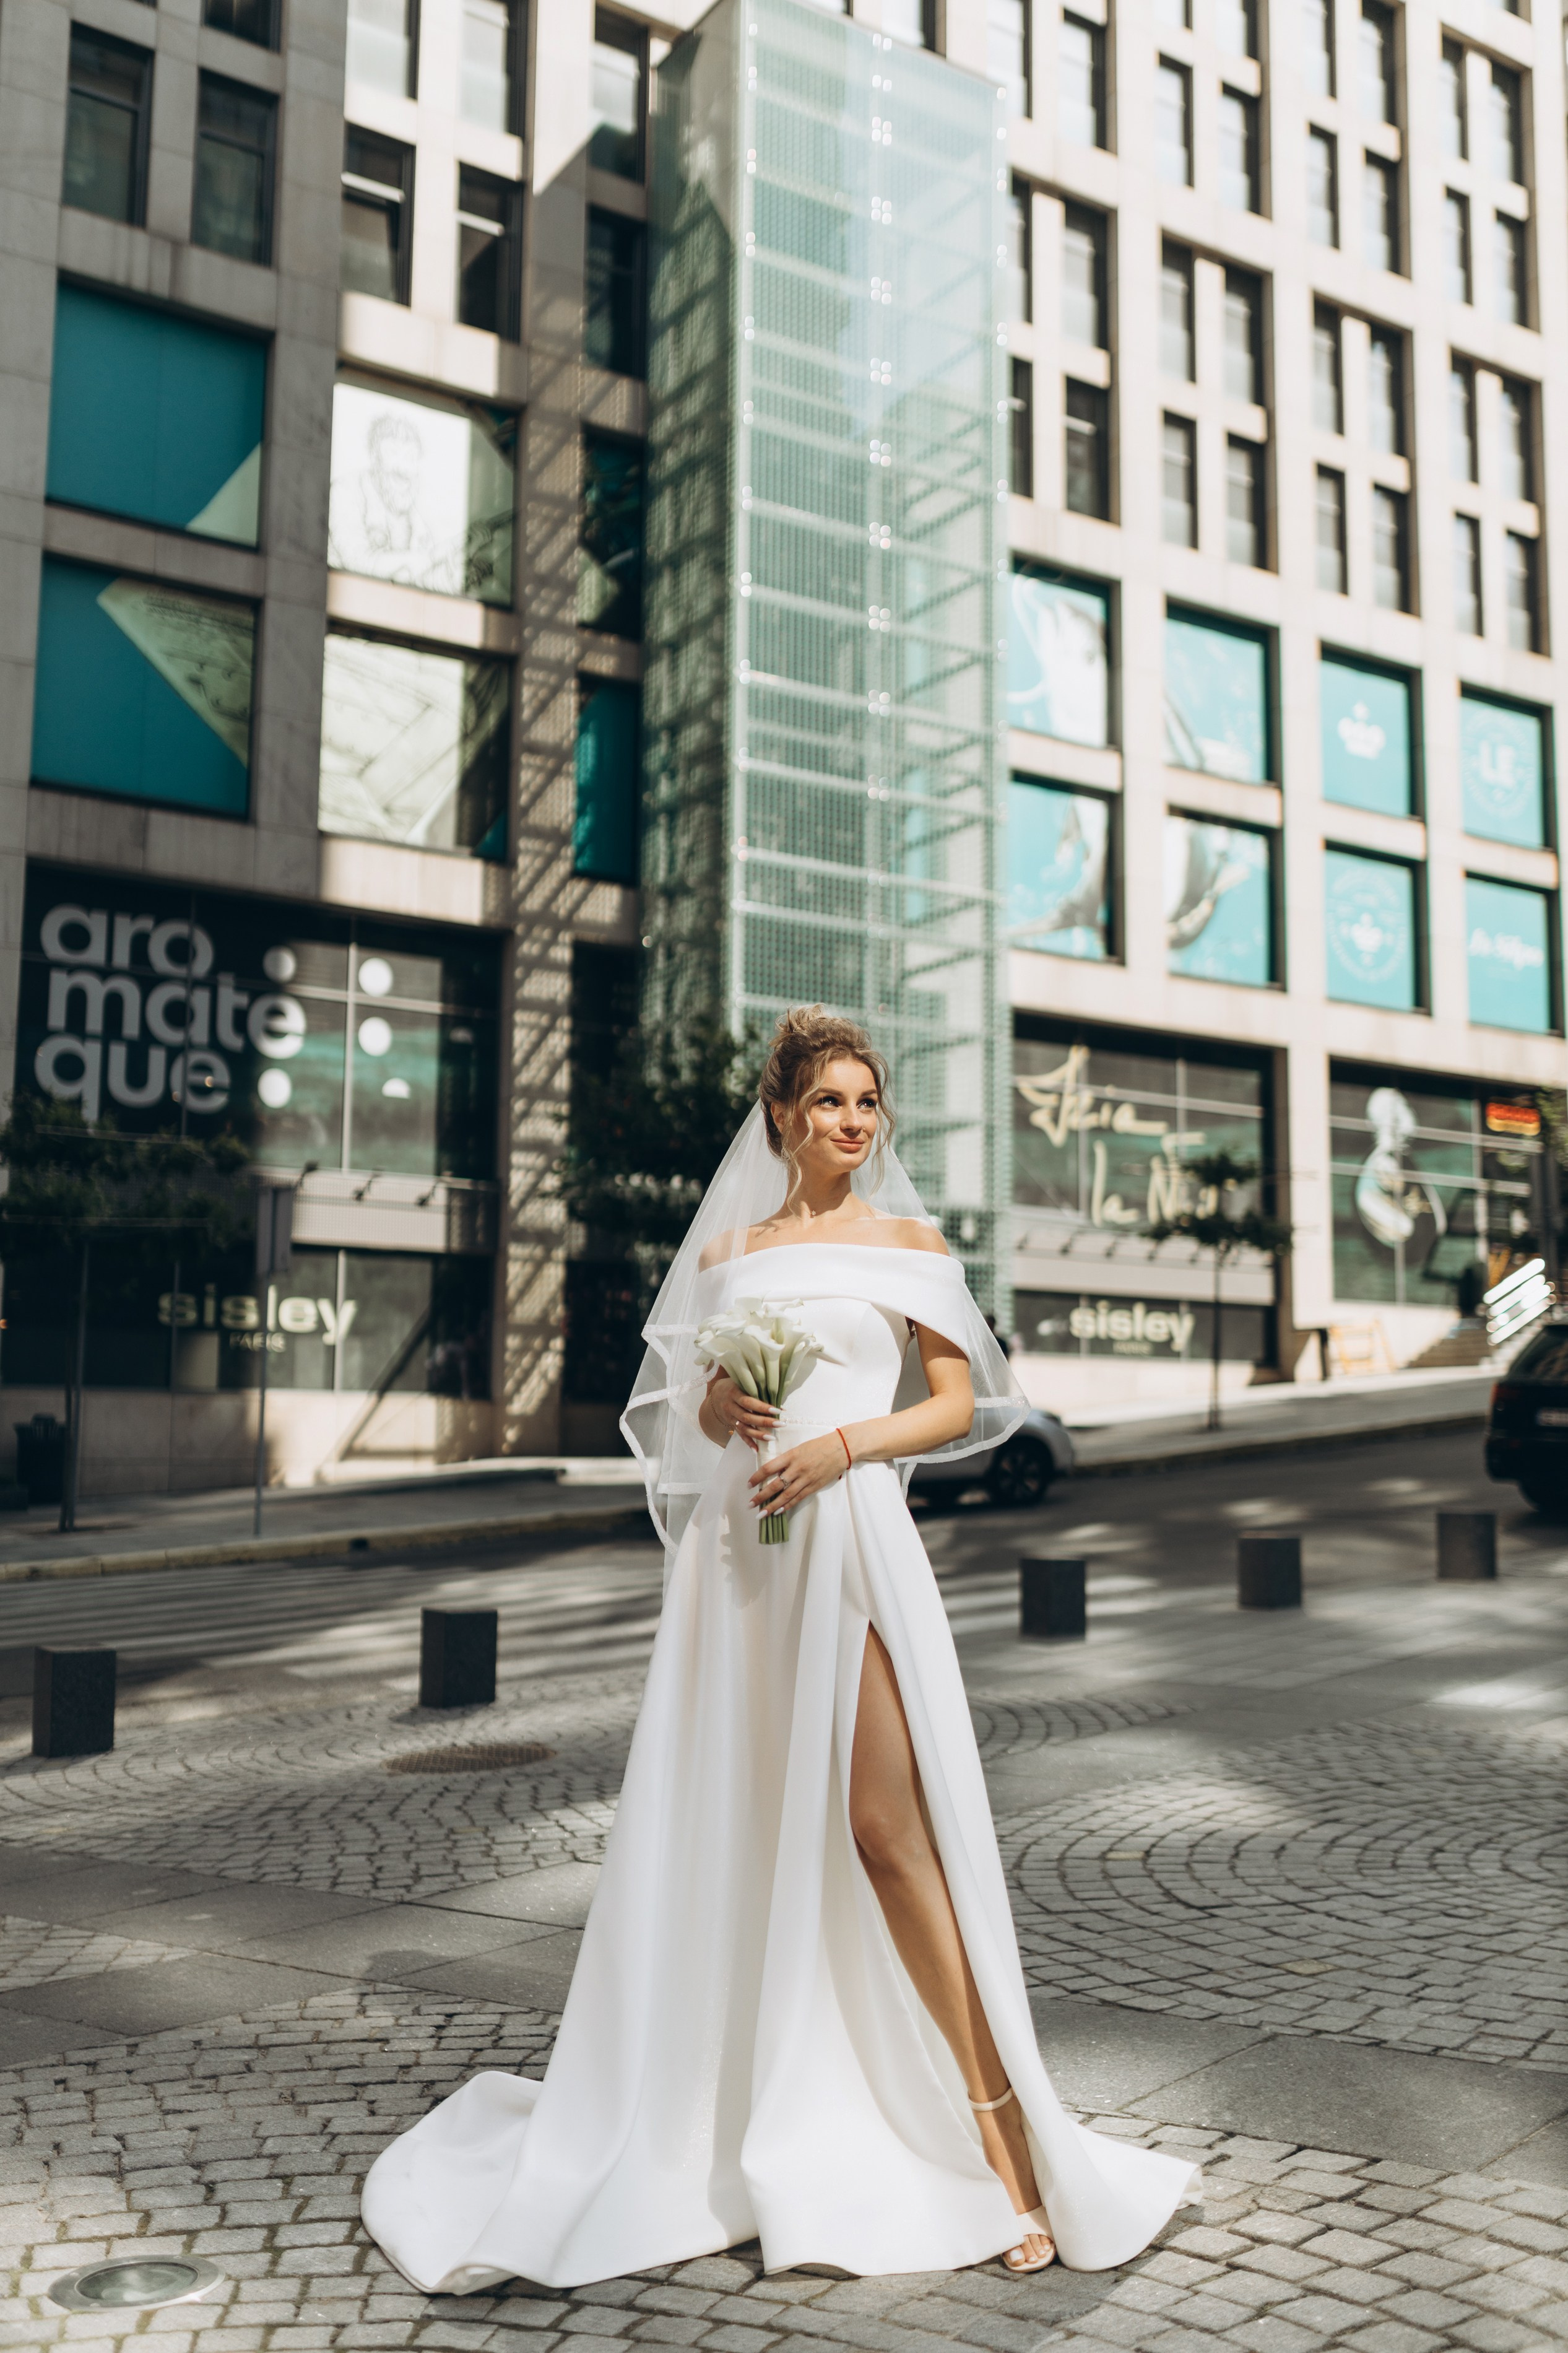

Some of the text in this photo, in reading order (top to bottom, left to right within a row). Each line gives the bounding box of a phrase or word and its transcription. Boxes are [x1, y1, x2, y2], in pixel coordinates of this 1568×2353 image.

[40, 903, 214, 980] aro
[47, 967, 307, 1060] mate
[34, 1032, 231, 1134] que
[157, 1282, 359, 1346] sisley
[1069, 1300, 1196, 1352] sisley
